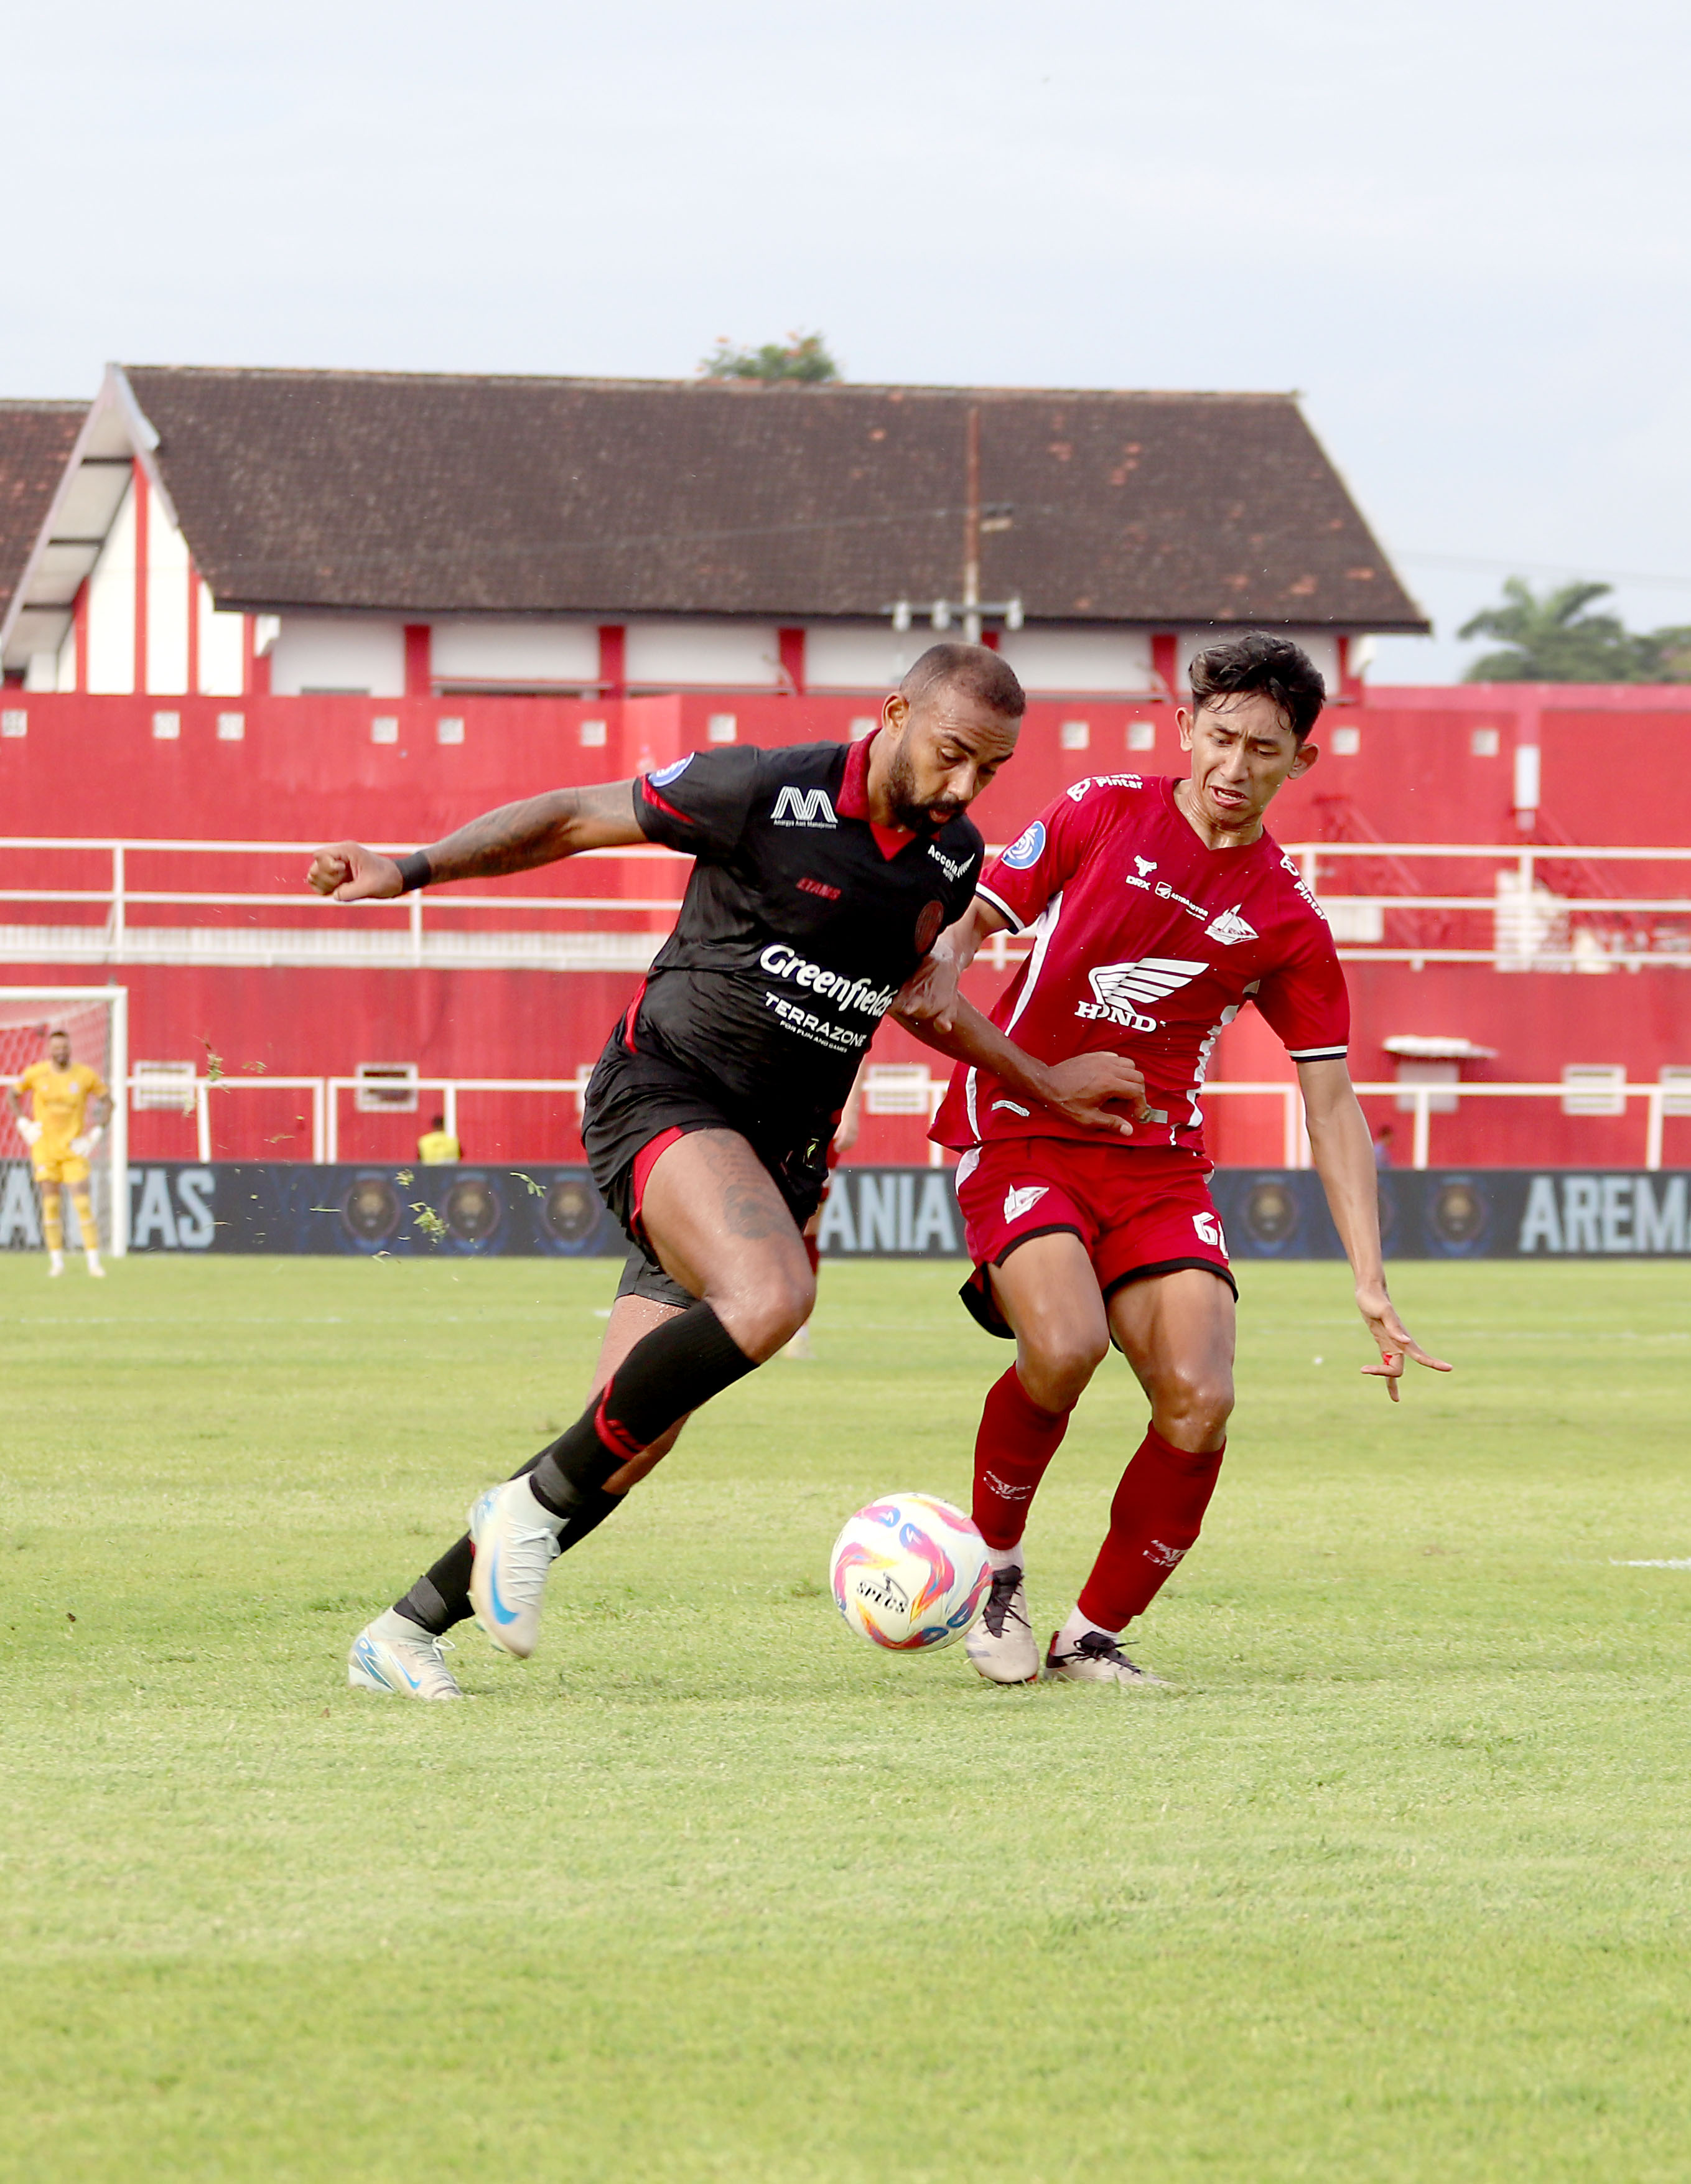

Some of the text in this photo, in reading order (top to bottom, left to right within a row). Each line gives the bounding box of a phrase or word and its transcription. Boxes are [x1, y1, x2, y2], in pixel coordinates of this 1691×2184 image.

[928, 844, 957, 875] Accola
[1125, 875, 1151, 890] DRX
[765, 991, 867, 1047] TERRAZONE
[1074, 1001, 1167, 1032] HOND
[780, 1020, 796, 1032] FOR
[796, 1029, 813, 1039] FUN
[813, 1036, 829, 1047] AND
[816, 1173, 957, 1252] ANIA
[1518, 1175, 1691, 1253] AREM
[857, 1582, 907, 1615] SPECS
